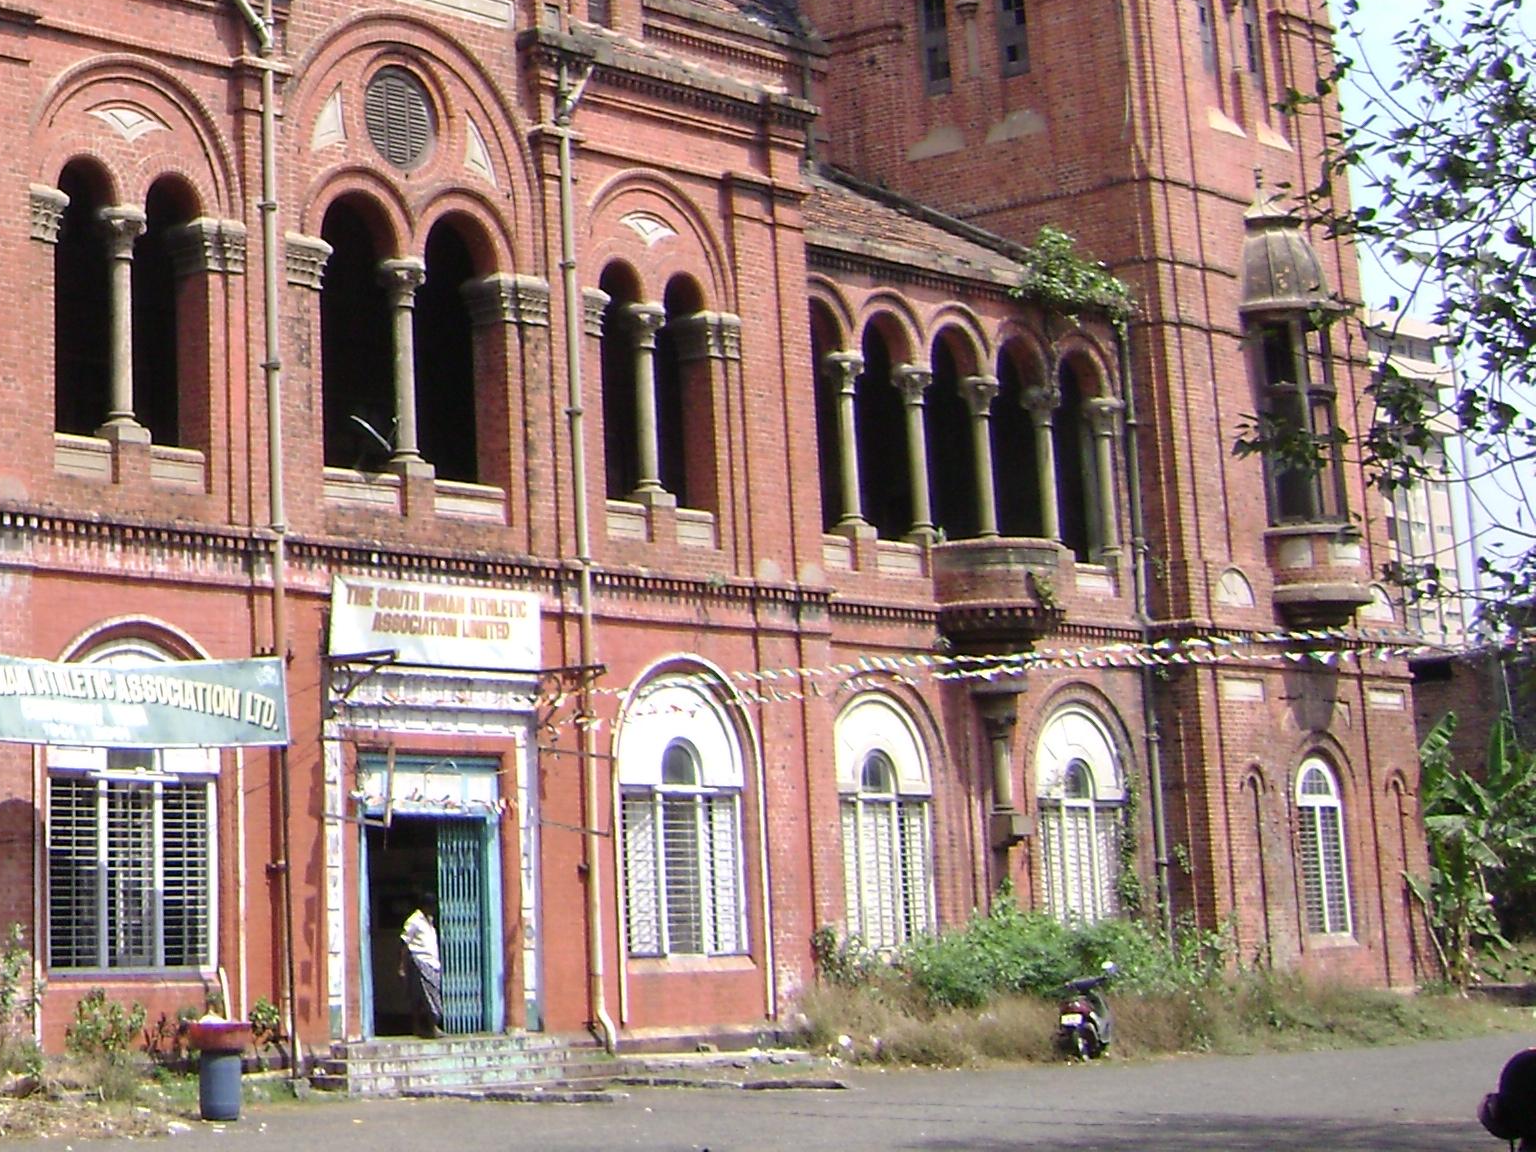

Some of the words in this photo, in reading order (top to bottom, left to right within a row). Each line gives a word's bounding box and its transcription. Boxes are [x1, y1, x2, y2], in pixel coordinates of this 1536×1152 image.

[346, 584, 373, 606] THE
[377, 588, 419, 610] SOUTH
[470, 597, 526, 617] ATHLETIC
[372, 612, 457, 637] ASSOCIATION
[32, 666, 115, 700] ATHLETIC
[115, 673, 241, 721] ASSOCIATION
[245, 691, 280, 732] LTD.
